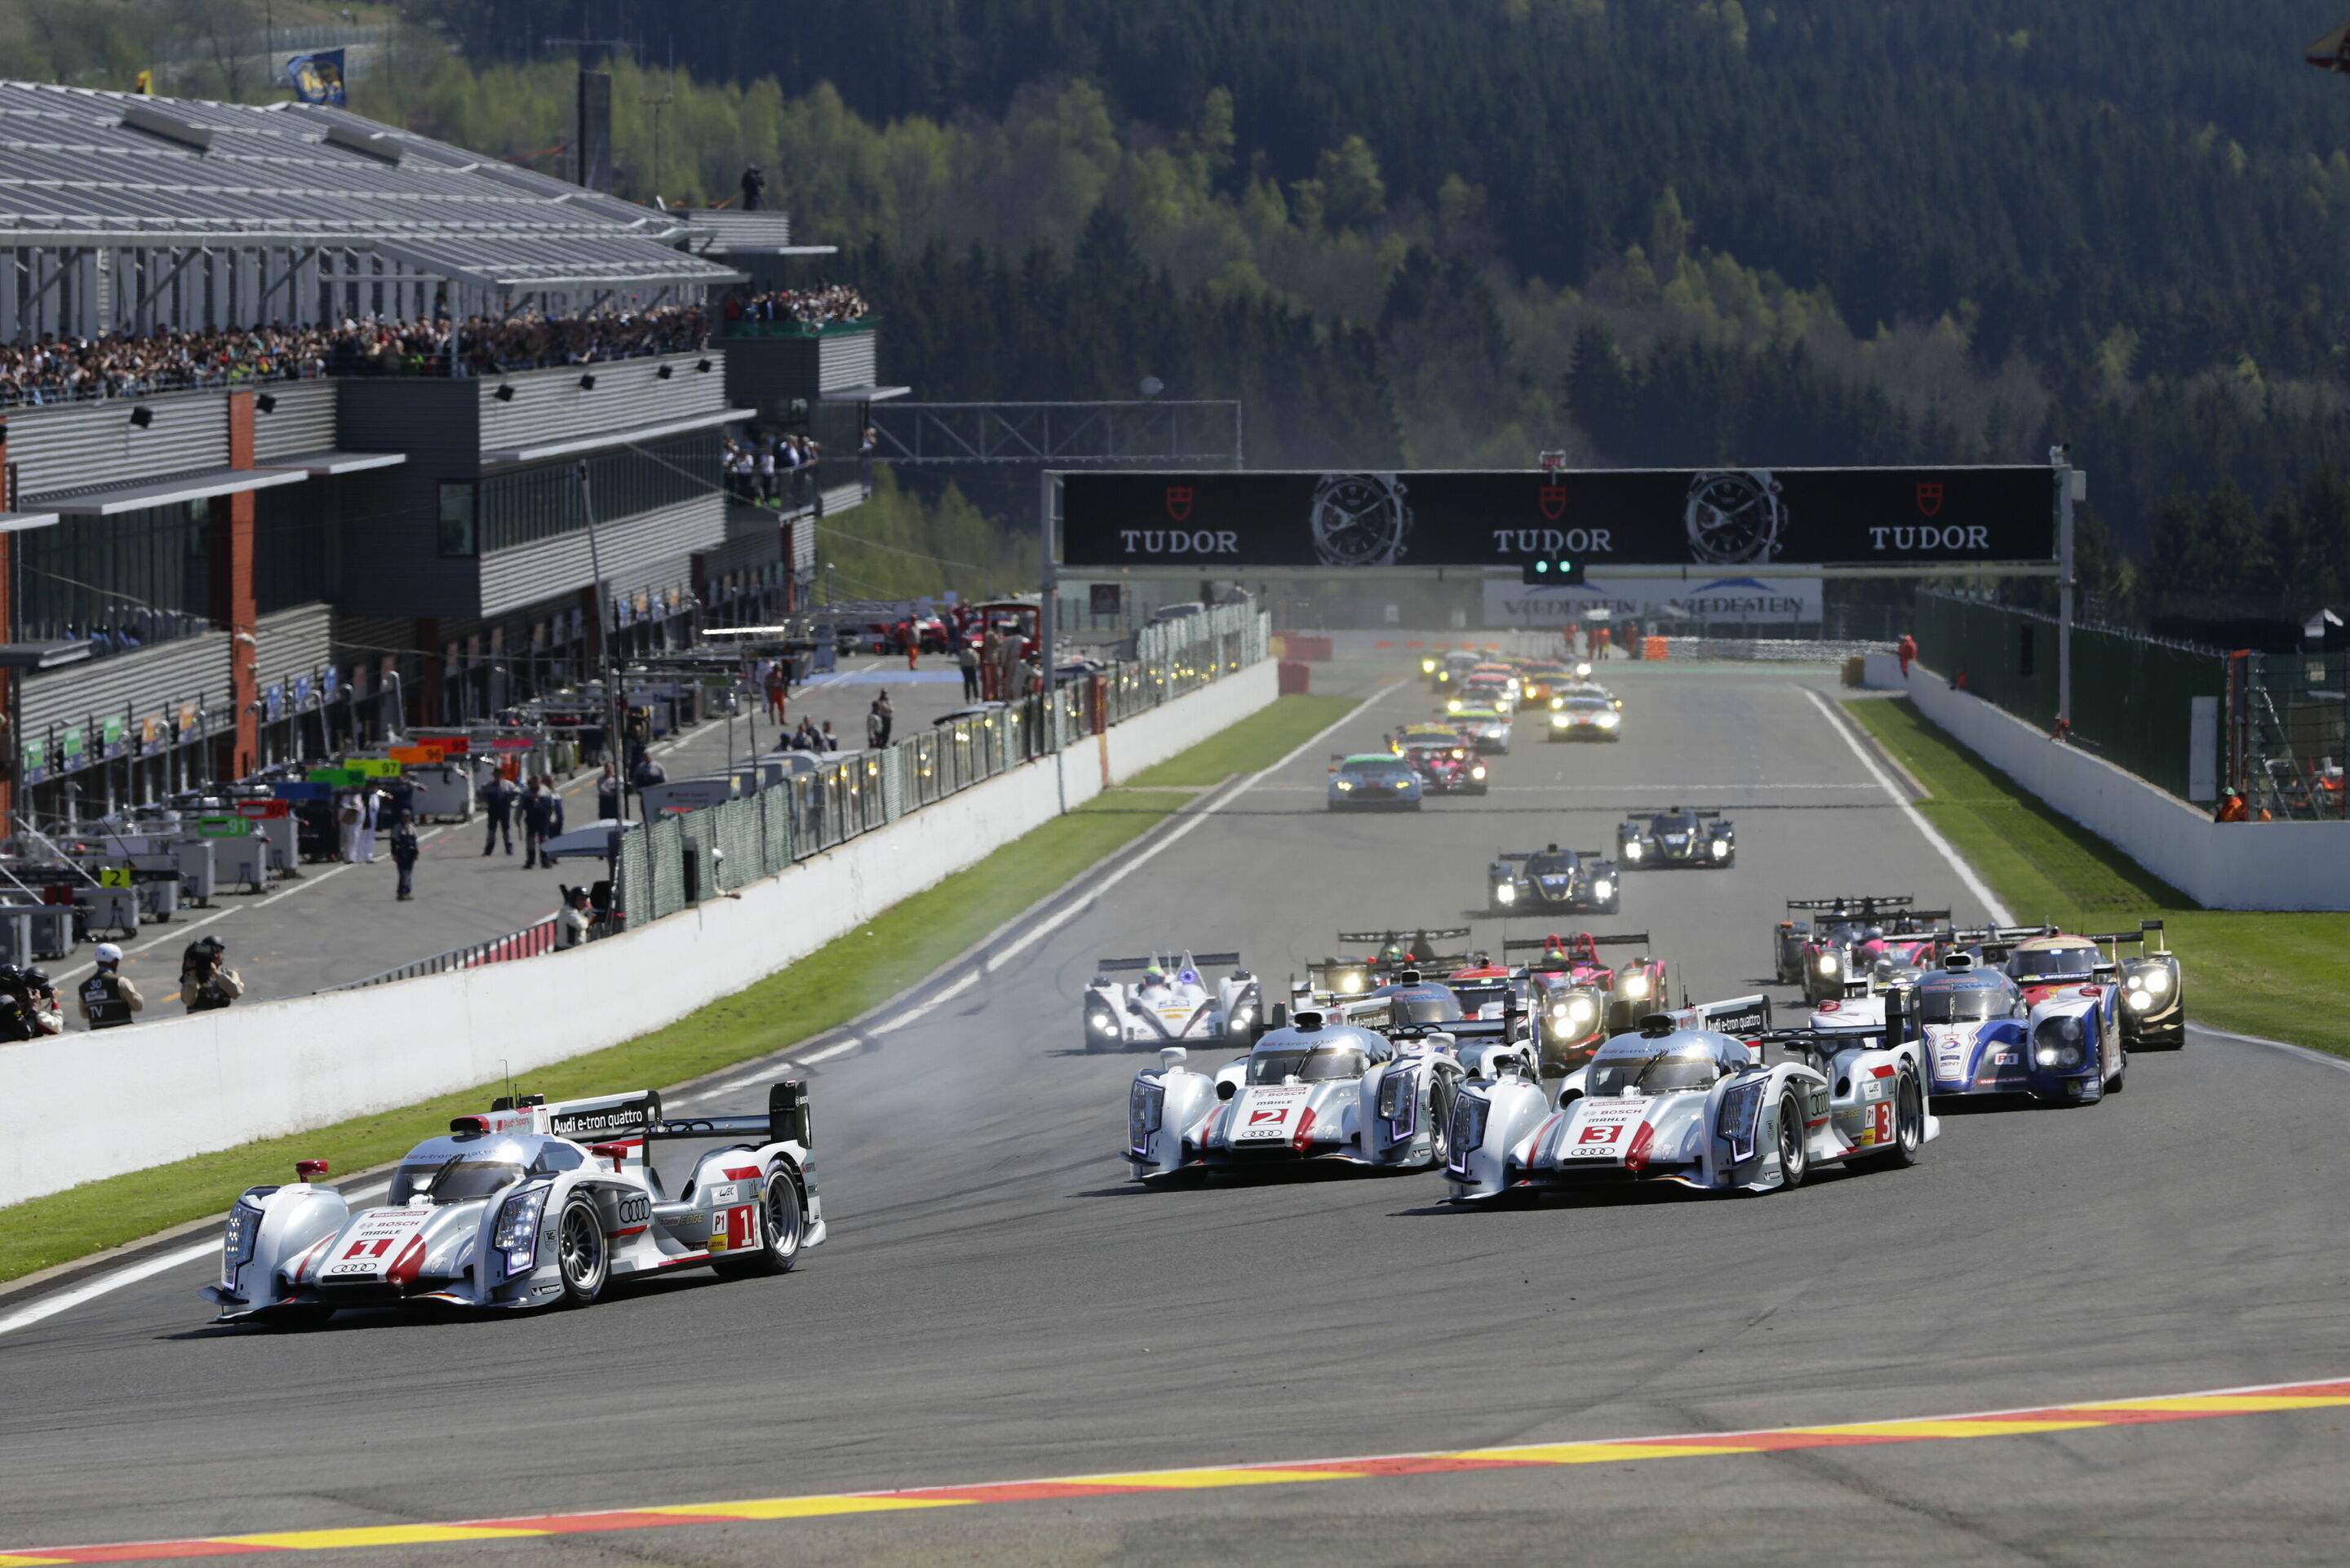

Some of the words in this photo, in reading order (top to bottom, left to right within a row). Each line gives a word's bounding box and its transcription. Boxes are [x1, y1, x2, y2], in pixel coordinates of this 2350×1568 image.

[1121, 529, 1239, 554] TUDOR
[1494, 529, 1613, 553] TUDOR
[1870, 525, 1989, 550] TUDOR
[382, 763, 397, 775] 97
[229, 818, 247, 834] 91
[110, 870, 122, 886] 2
[90, 979, 102, 990] 30
[89, 1005, 103, 1018] TV
[1722, 1018, 1739, 1031] e-tron
[1740, 1014, 1760, 1030] quattro
[1998, 1055, 2015, 1063] P1
[553, 1116, 576, 1134] Audi
[578, 1114, 605, 1129] e-tron
[607, 1110, 643, 1126] quattro
[1250, 1110, 1282, 1126] 2
[1866, 1110, 1874, 1126] P1
[1882, 1104, 1891, 1140] 3
[1585, 1127, 1614, 1143] 3
[714, 1214, 725, 1231] P1
[741, 1209, 752, 1247] 1
[348, 1240, 380, 1259] 1
